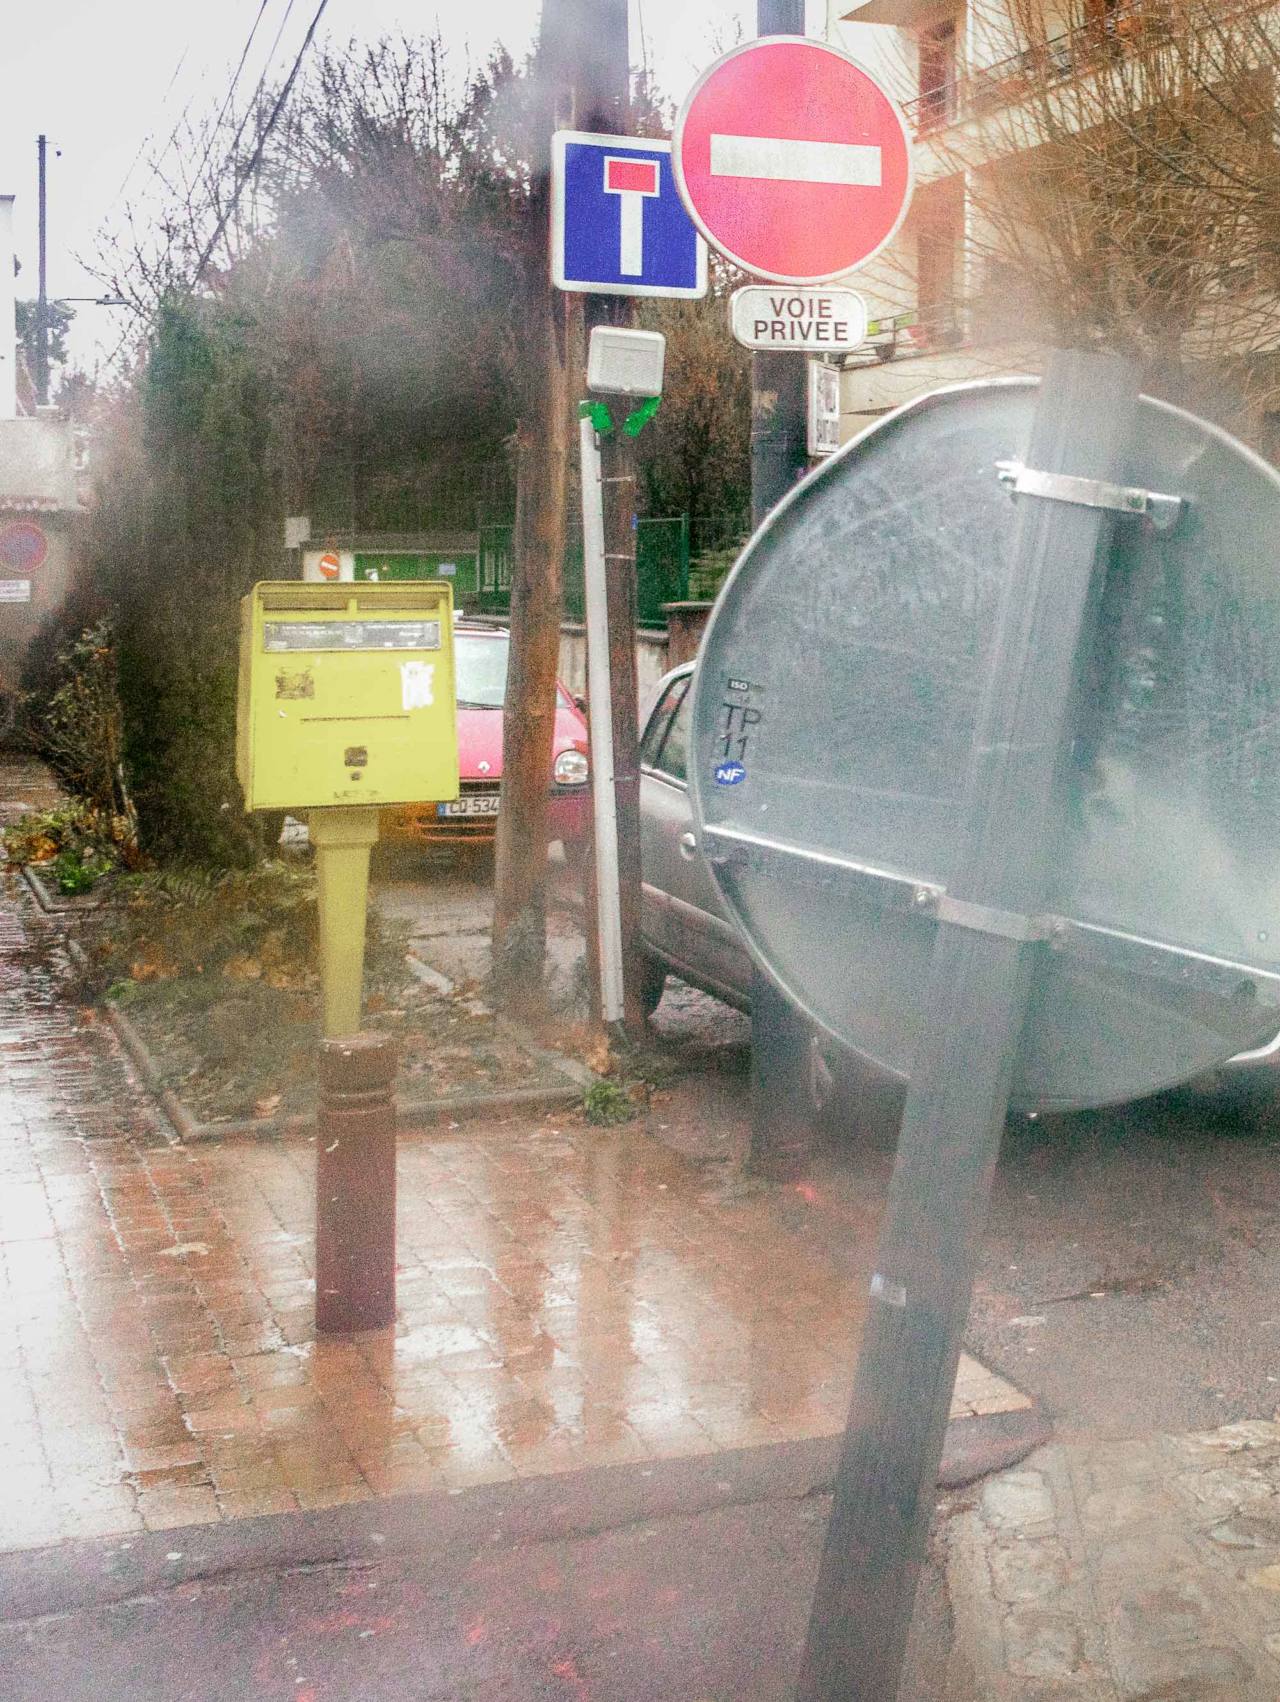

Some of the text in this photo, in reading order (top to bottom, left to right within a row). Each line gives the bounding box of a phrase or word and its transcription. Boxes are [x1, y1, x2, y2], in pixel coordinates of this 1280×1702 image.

[769, 297, 833, 319] VOIE
[753, 319, 849, 342] PRIVEE
[730, 680, 748, 691] ISO
[722, 702, 762, 733] TP
[716, 768, 745, 782] NF
